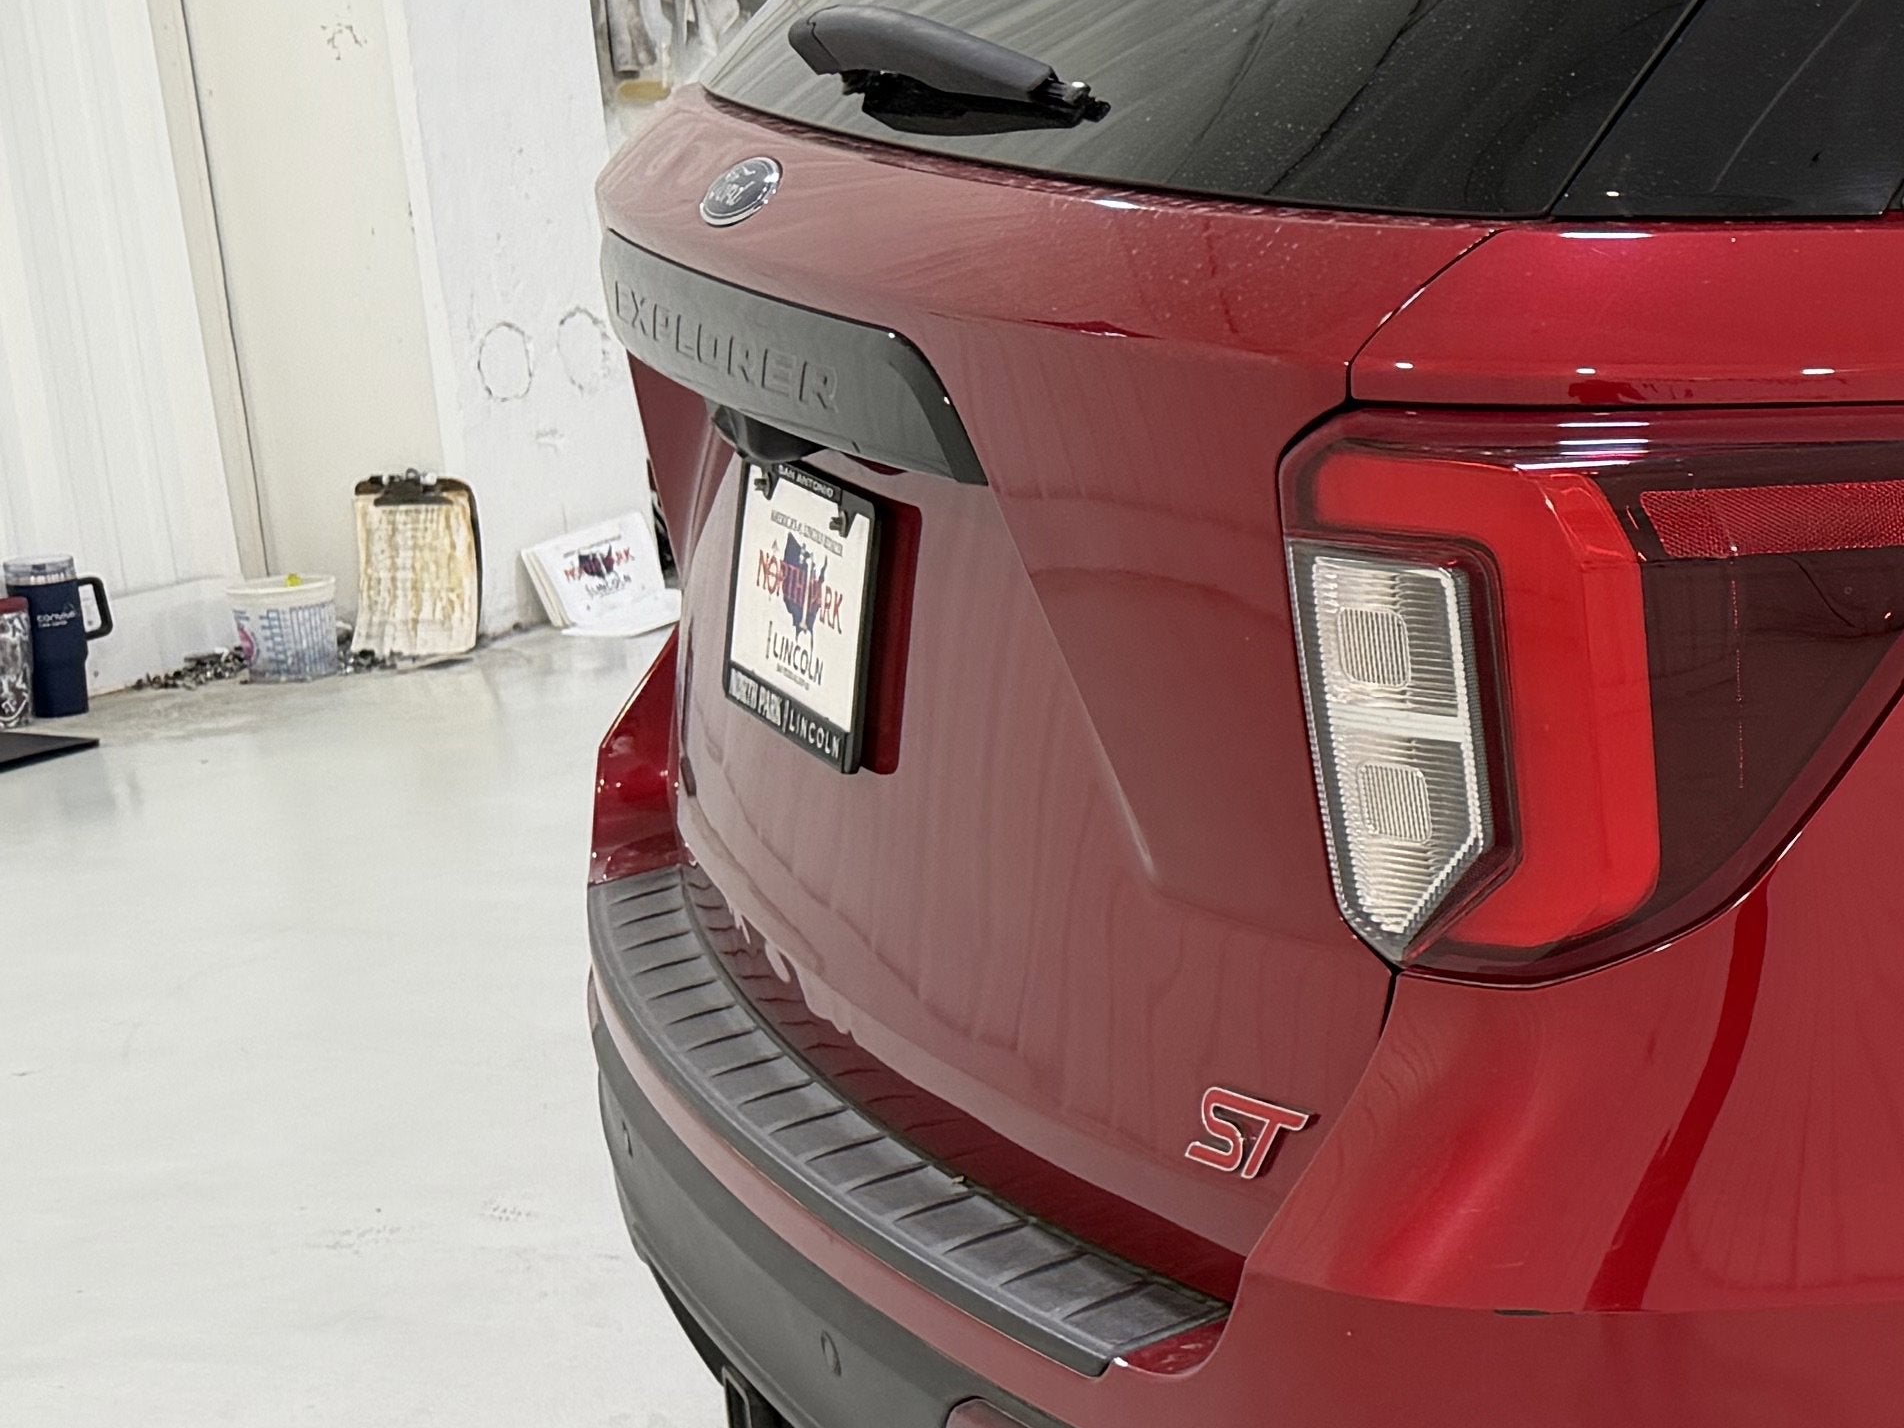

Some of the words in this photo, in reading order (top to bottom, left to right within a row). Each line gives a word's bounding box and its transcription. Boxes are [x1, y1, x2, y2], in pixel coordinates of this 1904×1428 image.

[615, 280, 840, 414] EXPLORER
[777, 464, 796, 480] SAN
[795, 472, 834, 498] ANTONIO
[772, 632, 824, 686] LINCOLN
[788, 709, 841, 759] LINCOLN
[1184, 1086, 1310, 1180] ST
